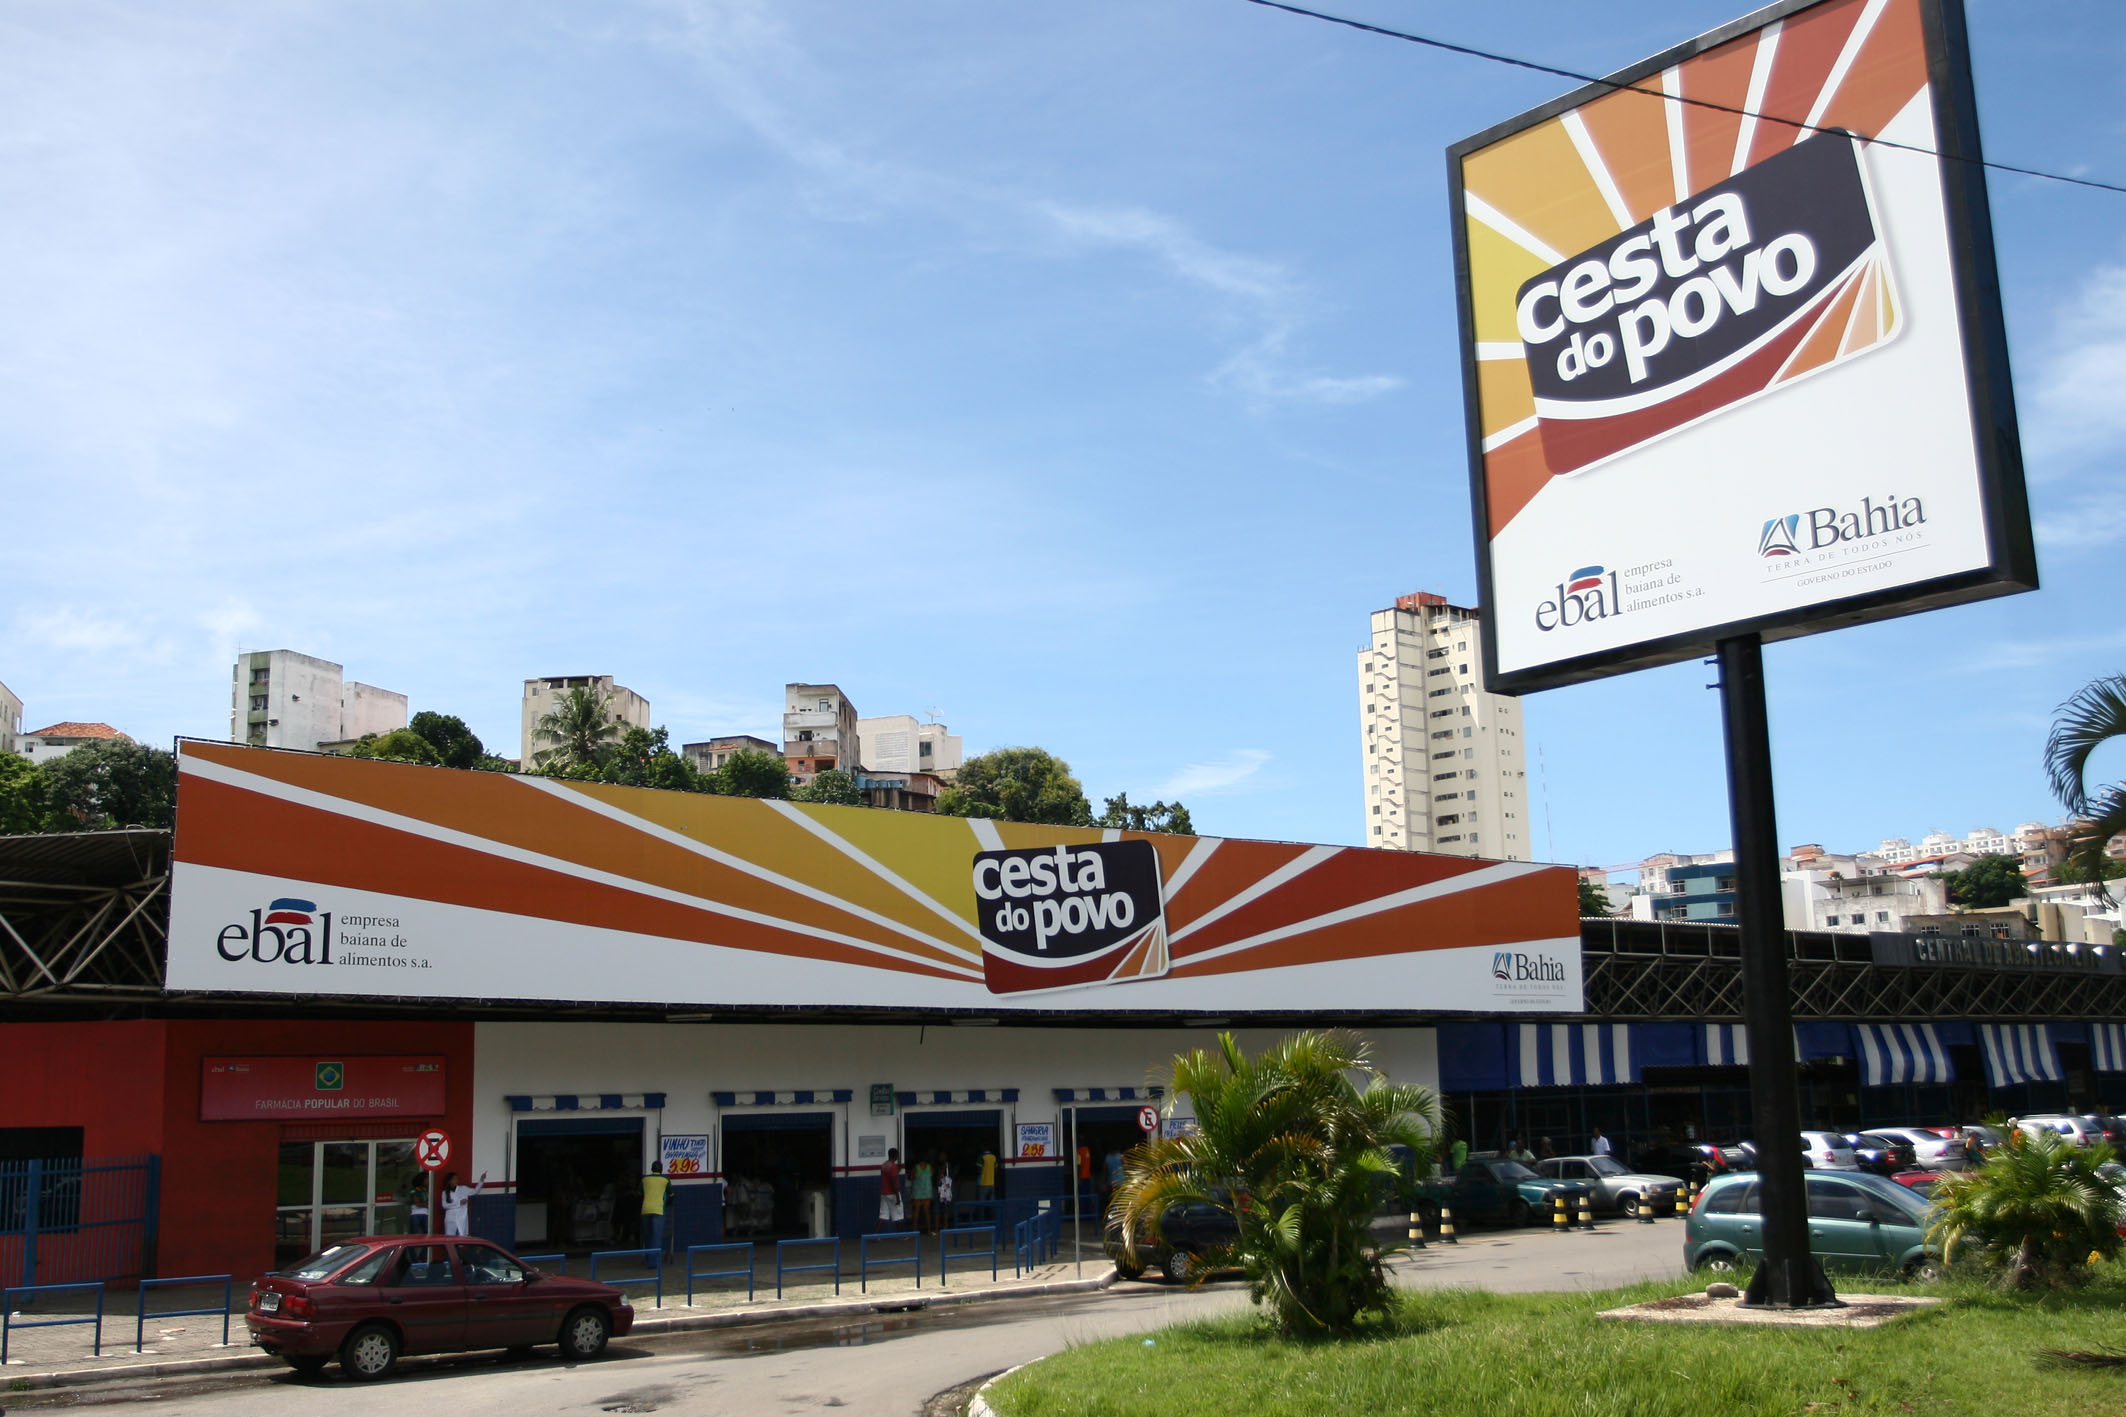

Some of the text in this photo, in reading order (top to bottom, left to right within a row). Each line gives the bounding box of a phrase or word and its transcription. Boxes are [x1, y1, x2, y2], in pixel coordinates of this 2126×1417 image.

[1517, 191, 1752, 344] cesta
[1556, 232, 1816, 384] do povo
[1803, 494, 1927, 551] Bahia
[1624, 558, 1673, 579] empresa
[1767, 557, 1811, 573] TERRA
[1818, 551, 1835, 562] DE
[1843, 539, 1888, 556] TODOS
[1625, 572, 1681, 596] baiana de
[1796, 560, 1893, 588] GOVERNO DO ESTADO
[1535, 569, 1623, 632] ebal
[1626, 587, 1706, 613] alimentos s.a.
[973, 844, 1106, 900] cesta
[341, 914, 400, 930] empresa
[995, 891, 1135, 950] do povo
[216, 908, 334, 965] ebal
[340, 933, 408, 948] baiana de
[339, 952, 433, 969] alimentos s.a.
[1514, 953, 1565, 981] Bahia
[304, 1098, 350, 1109] POPULAR
[353, 1098, 366, 1108] DO
[368, 1097, 400, 1108] BRASIL
[663, 1138, 689, 1151] VINHO
